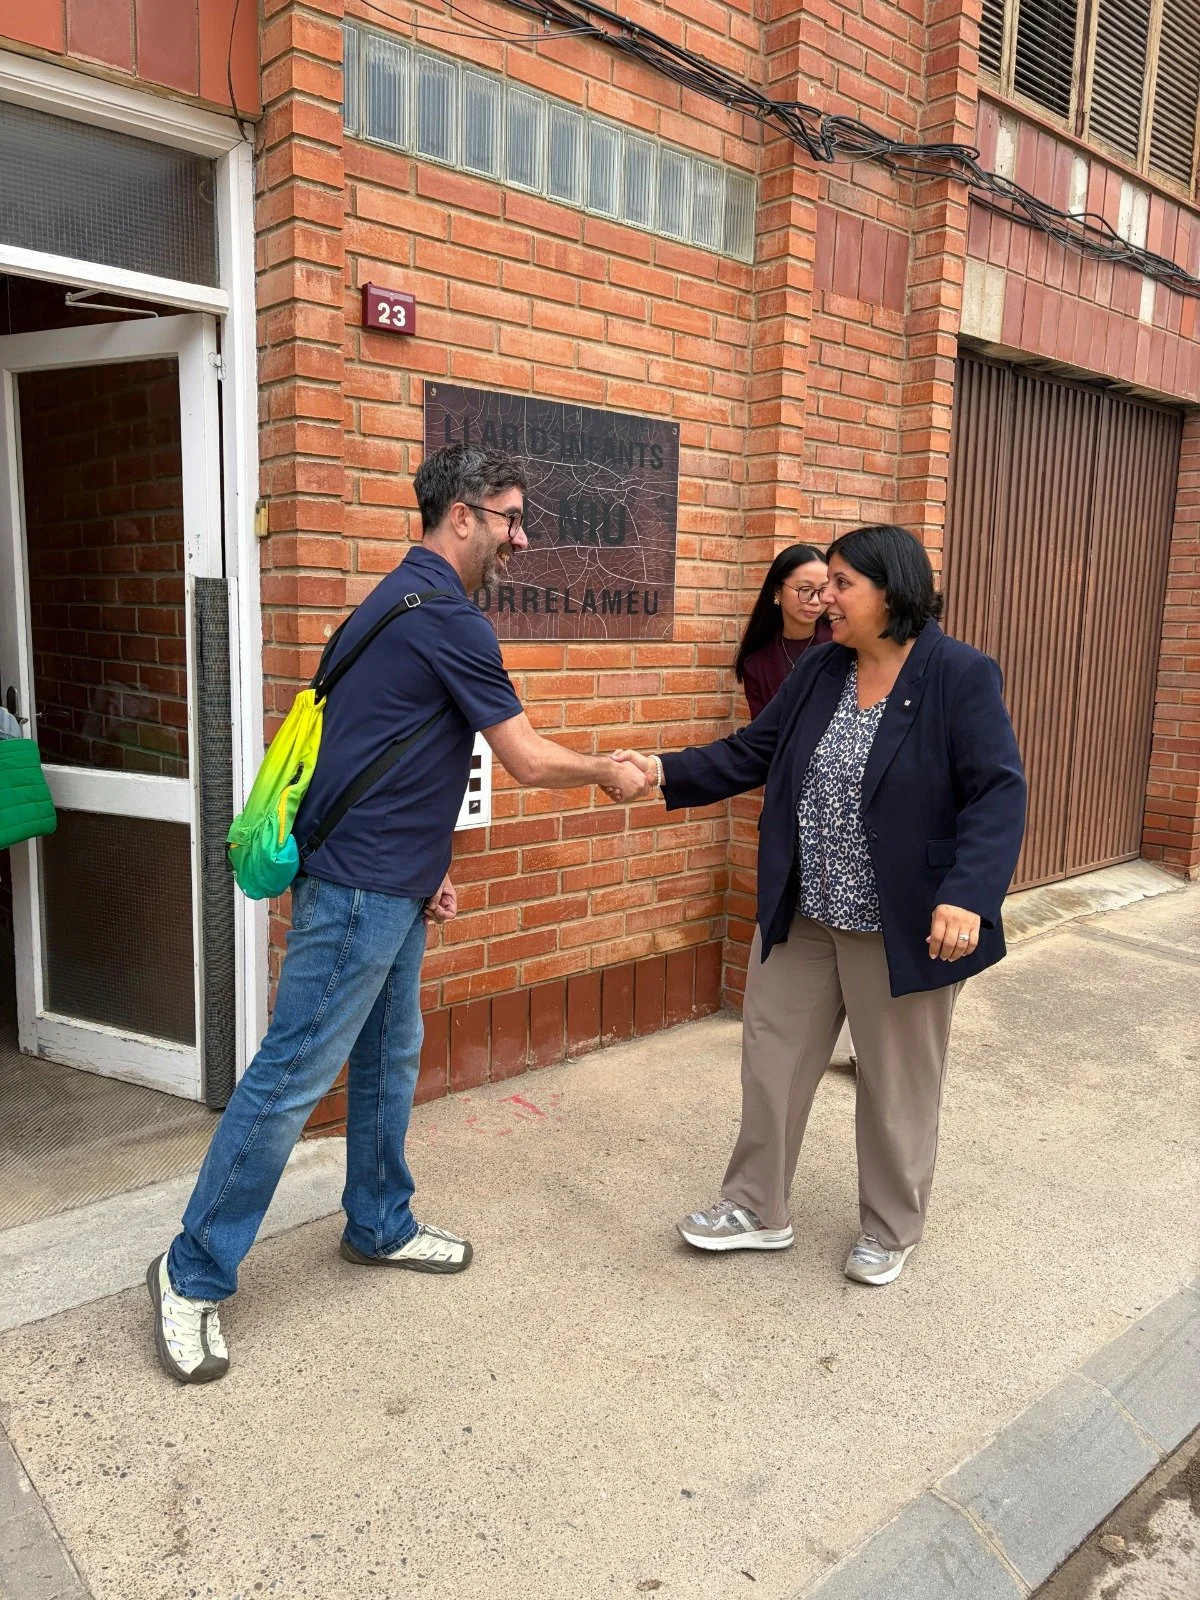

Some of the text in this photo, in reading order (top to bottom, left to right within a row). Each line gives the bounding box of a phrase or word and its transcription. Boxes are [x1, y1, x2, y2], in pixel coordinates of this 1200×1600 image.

[377, 302, 406, 327] 23
[444, 413, 520, 453] LLAR
[558, 497, 627, 545] NIU
[473, 584, 659, 616] ORRELAMEU
